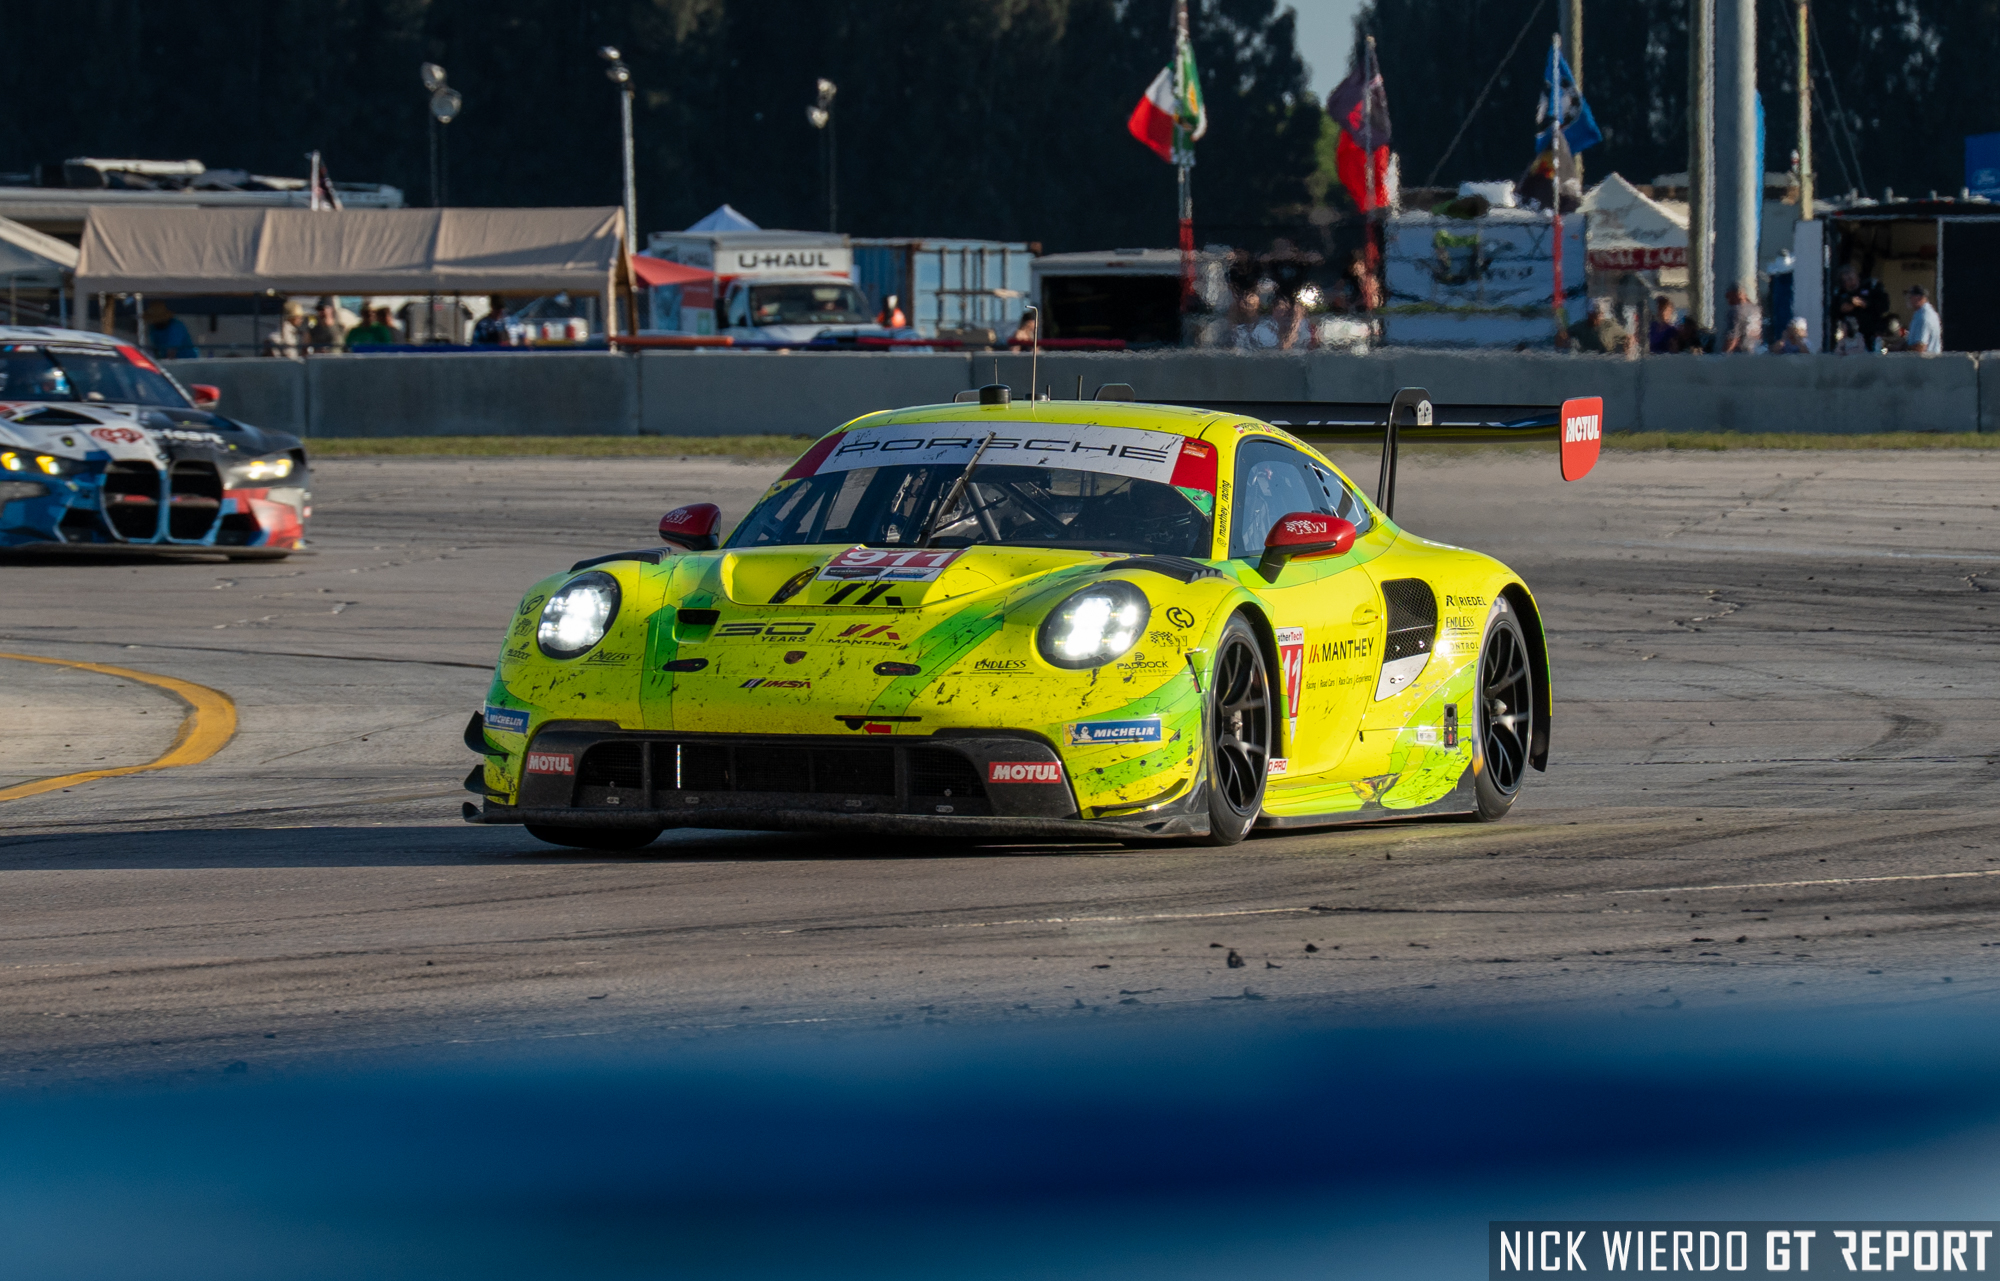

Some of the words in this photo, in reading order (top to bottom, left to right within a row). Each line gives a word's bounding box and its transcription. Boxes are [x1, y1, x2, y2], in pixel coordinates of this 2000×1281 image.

[739, 253, 830, 268] U-HAUL
[1565, 414, 1600, 443] MOTUL
[834, 437, 1169, 464] PORSCHE
[840, 550, 954, 567] 911
[1458, 596, 1487, 606] RIEDEL
[1446, 616, 1475, 628] ENDLESS
[828, 638, 902, 648] MANTHEY
[1449, 641, 1480, 650] ONTROL
[1322, 637, 1375, 663] MANTHEY
[974, 659, 1027, 669] ENDLESS
[1116, 661, 1169, 669] PADDOCK
[761, 679, 812, 689] IMSA
[489, 713, 524, 727] MICHELIN
[1093, 726, 1156, 738] MICHELIN
[528, 755, 573, 772] MOTUL
[1273, 760, 1287, 771] PRO
[992, 765, 1059, 780] MOTUL
